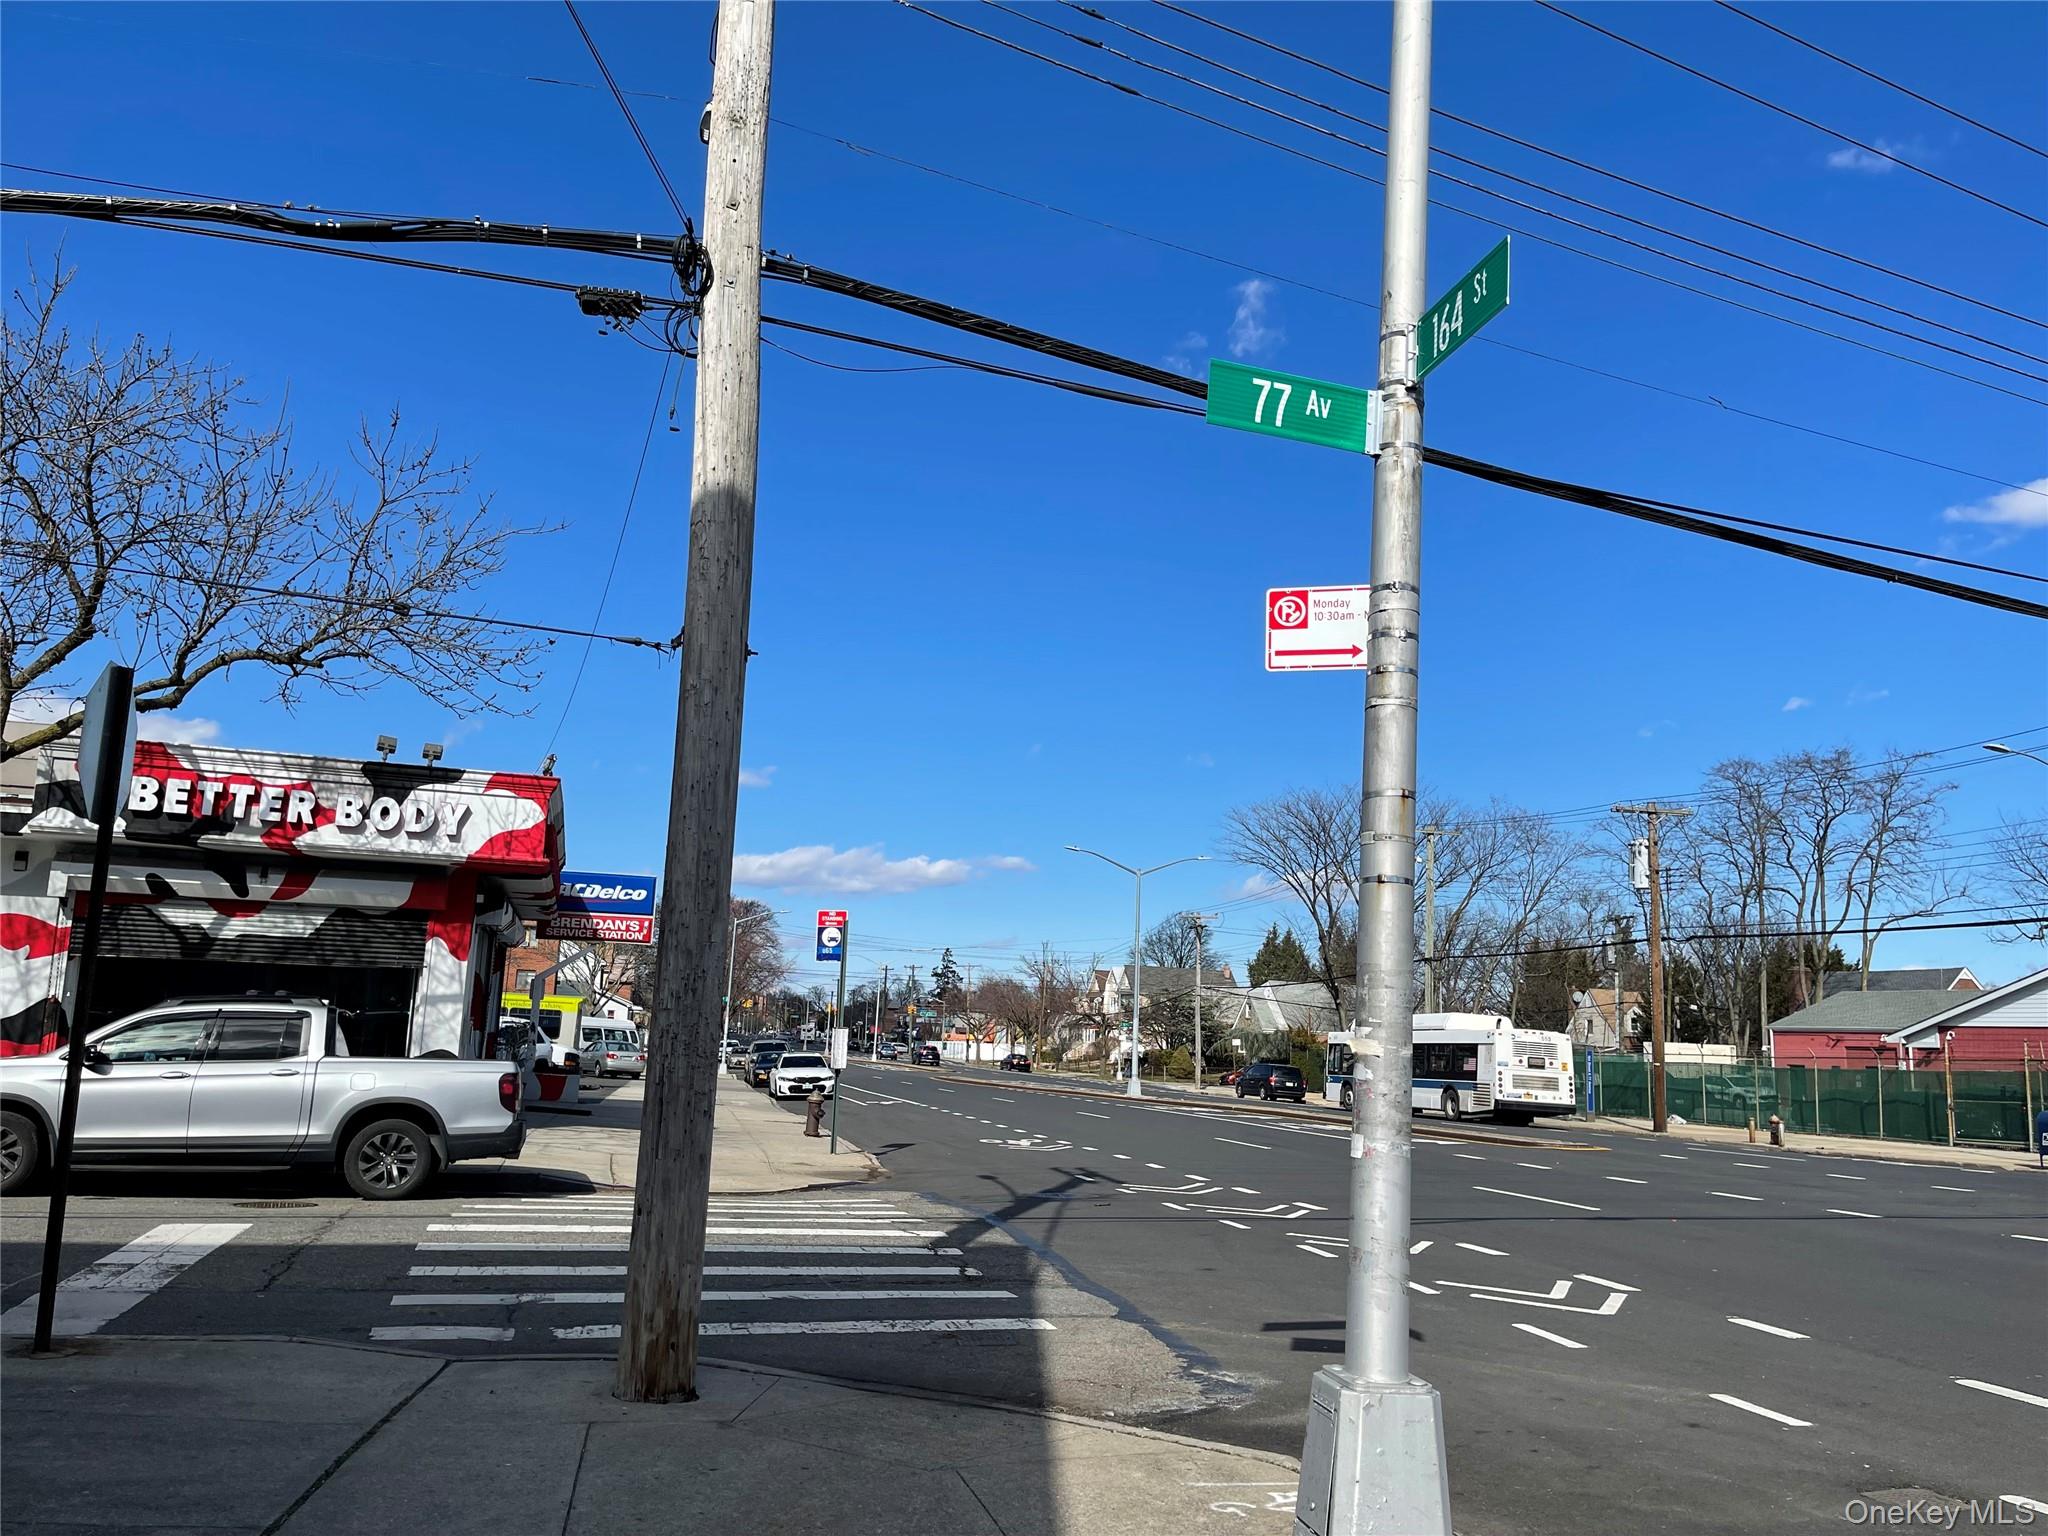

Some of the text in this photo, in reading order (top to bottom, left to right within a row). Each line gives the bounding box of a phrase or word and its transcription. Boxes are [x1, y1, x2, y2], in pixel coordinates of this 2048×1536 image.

[1432, 268, 1487, 358] 164 St
[1252, 377, 1332, 427] 77 Av
[1313, 599, 1351, 609] Monday
[1314, 611, 1354, 621] 10:30am
[127, 776, 472, 838] BETTER BODY
[560, 882, 648, 901] ACDelco
[550, 917, 640, 932] BRENDAN'S
[546, 927, 644, 941] SERVICE STATION
